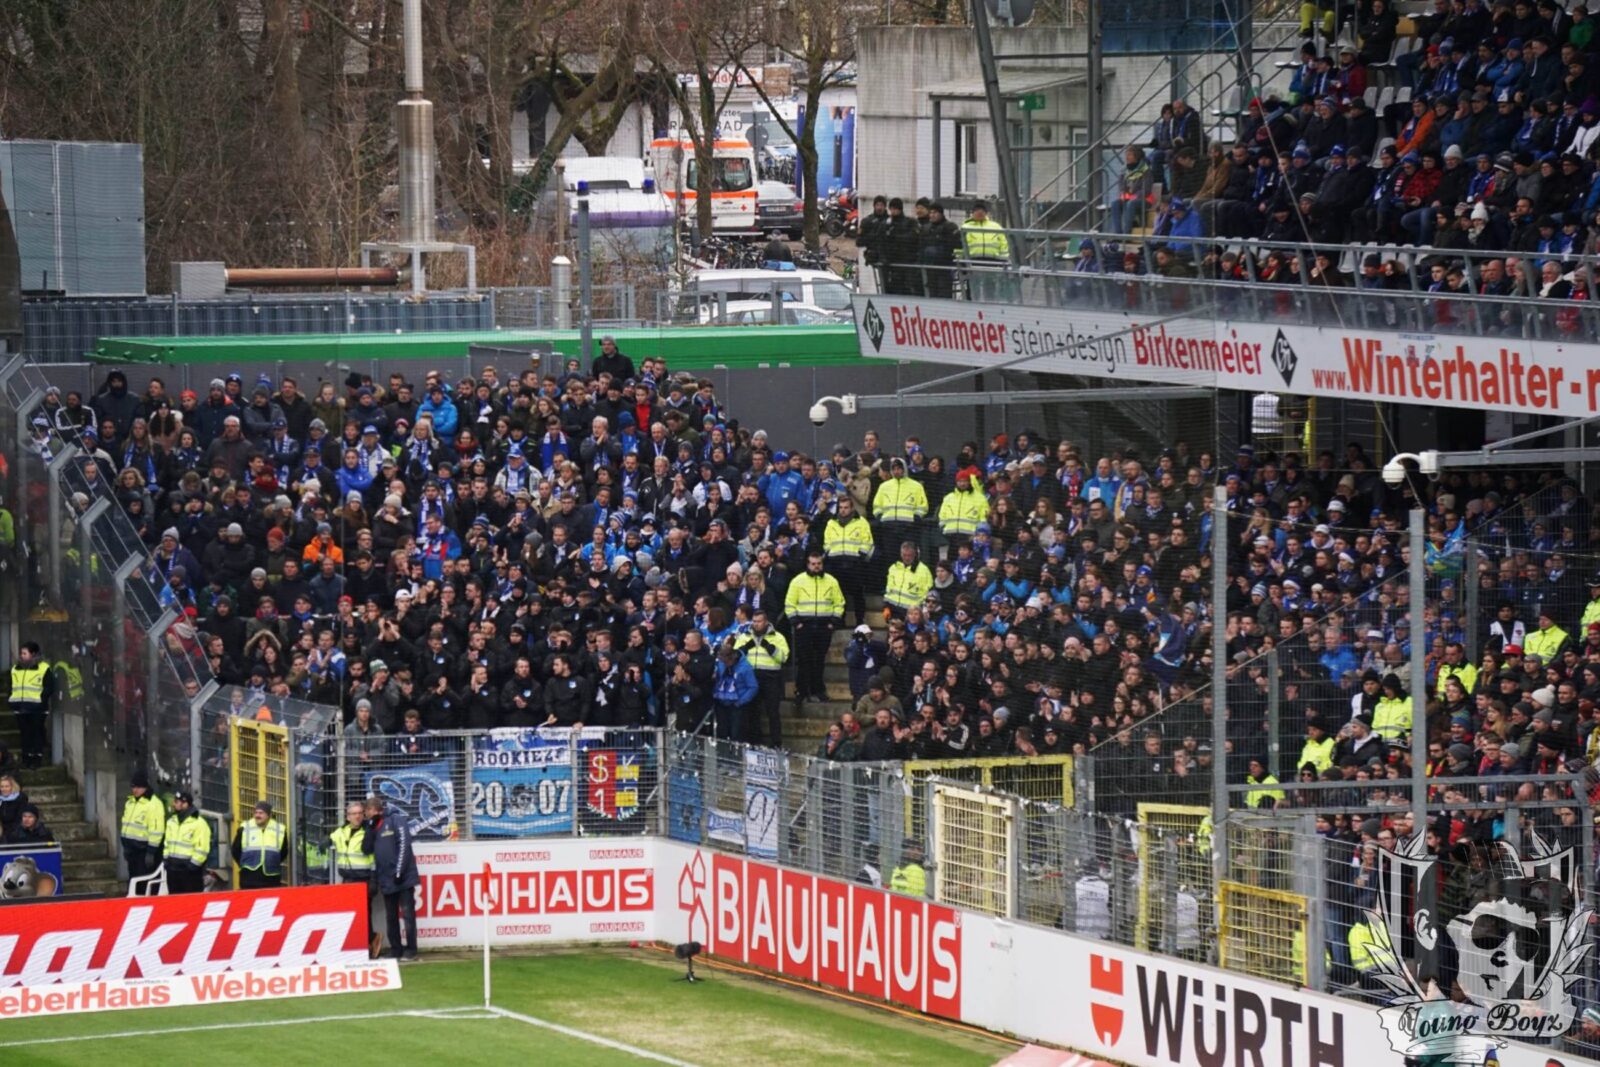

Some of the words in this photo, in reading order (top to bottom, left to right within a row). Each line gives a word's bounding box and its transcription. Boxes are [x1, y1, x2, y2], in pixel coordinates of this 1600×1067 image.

[890, 305, 1006, 353] Birkenmeier
[1131, 323, 1262, 375] Birkenmeier
[472, 781, 503, 818] 20
[539, 779, 572, 815] 07
[413, 854, 457, 864] UHAUS
[496, 851, 551, 862] BAUHAUS
[589, 848, 644, 860] BAUHAUS
[496, 925, 551, 936] BAUHAUS
[590, 922, 645, 933] BAUHAUS
[716, 867, 958, 1000] BAUHAUS
[0, 982, 171, 1016] eberHaus
[191, 966, 389, 1002] WeberHaus
[1136, 964, 1345, 1067] WÜRTH
